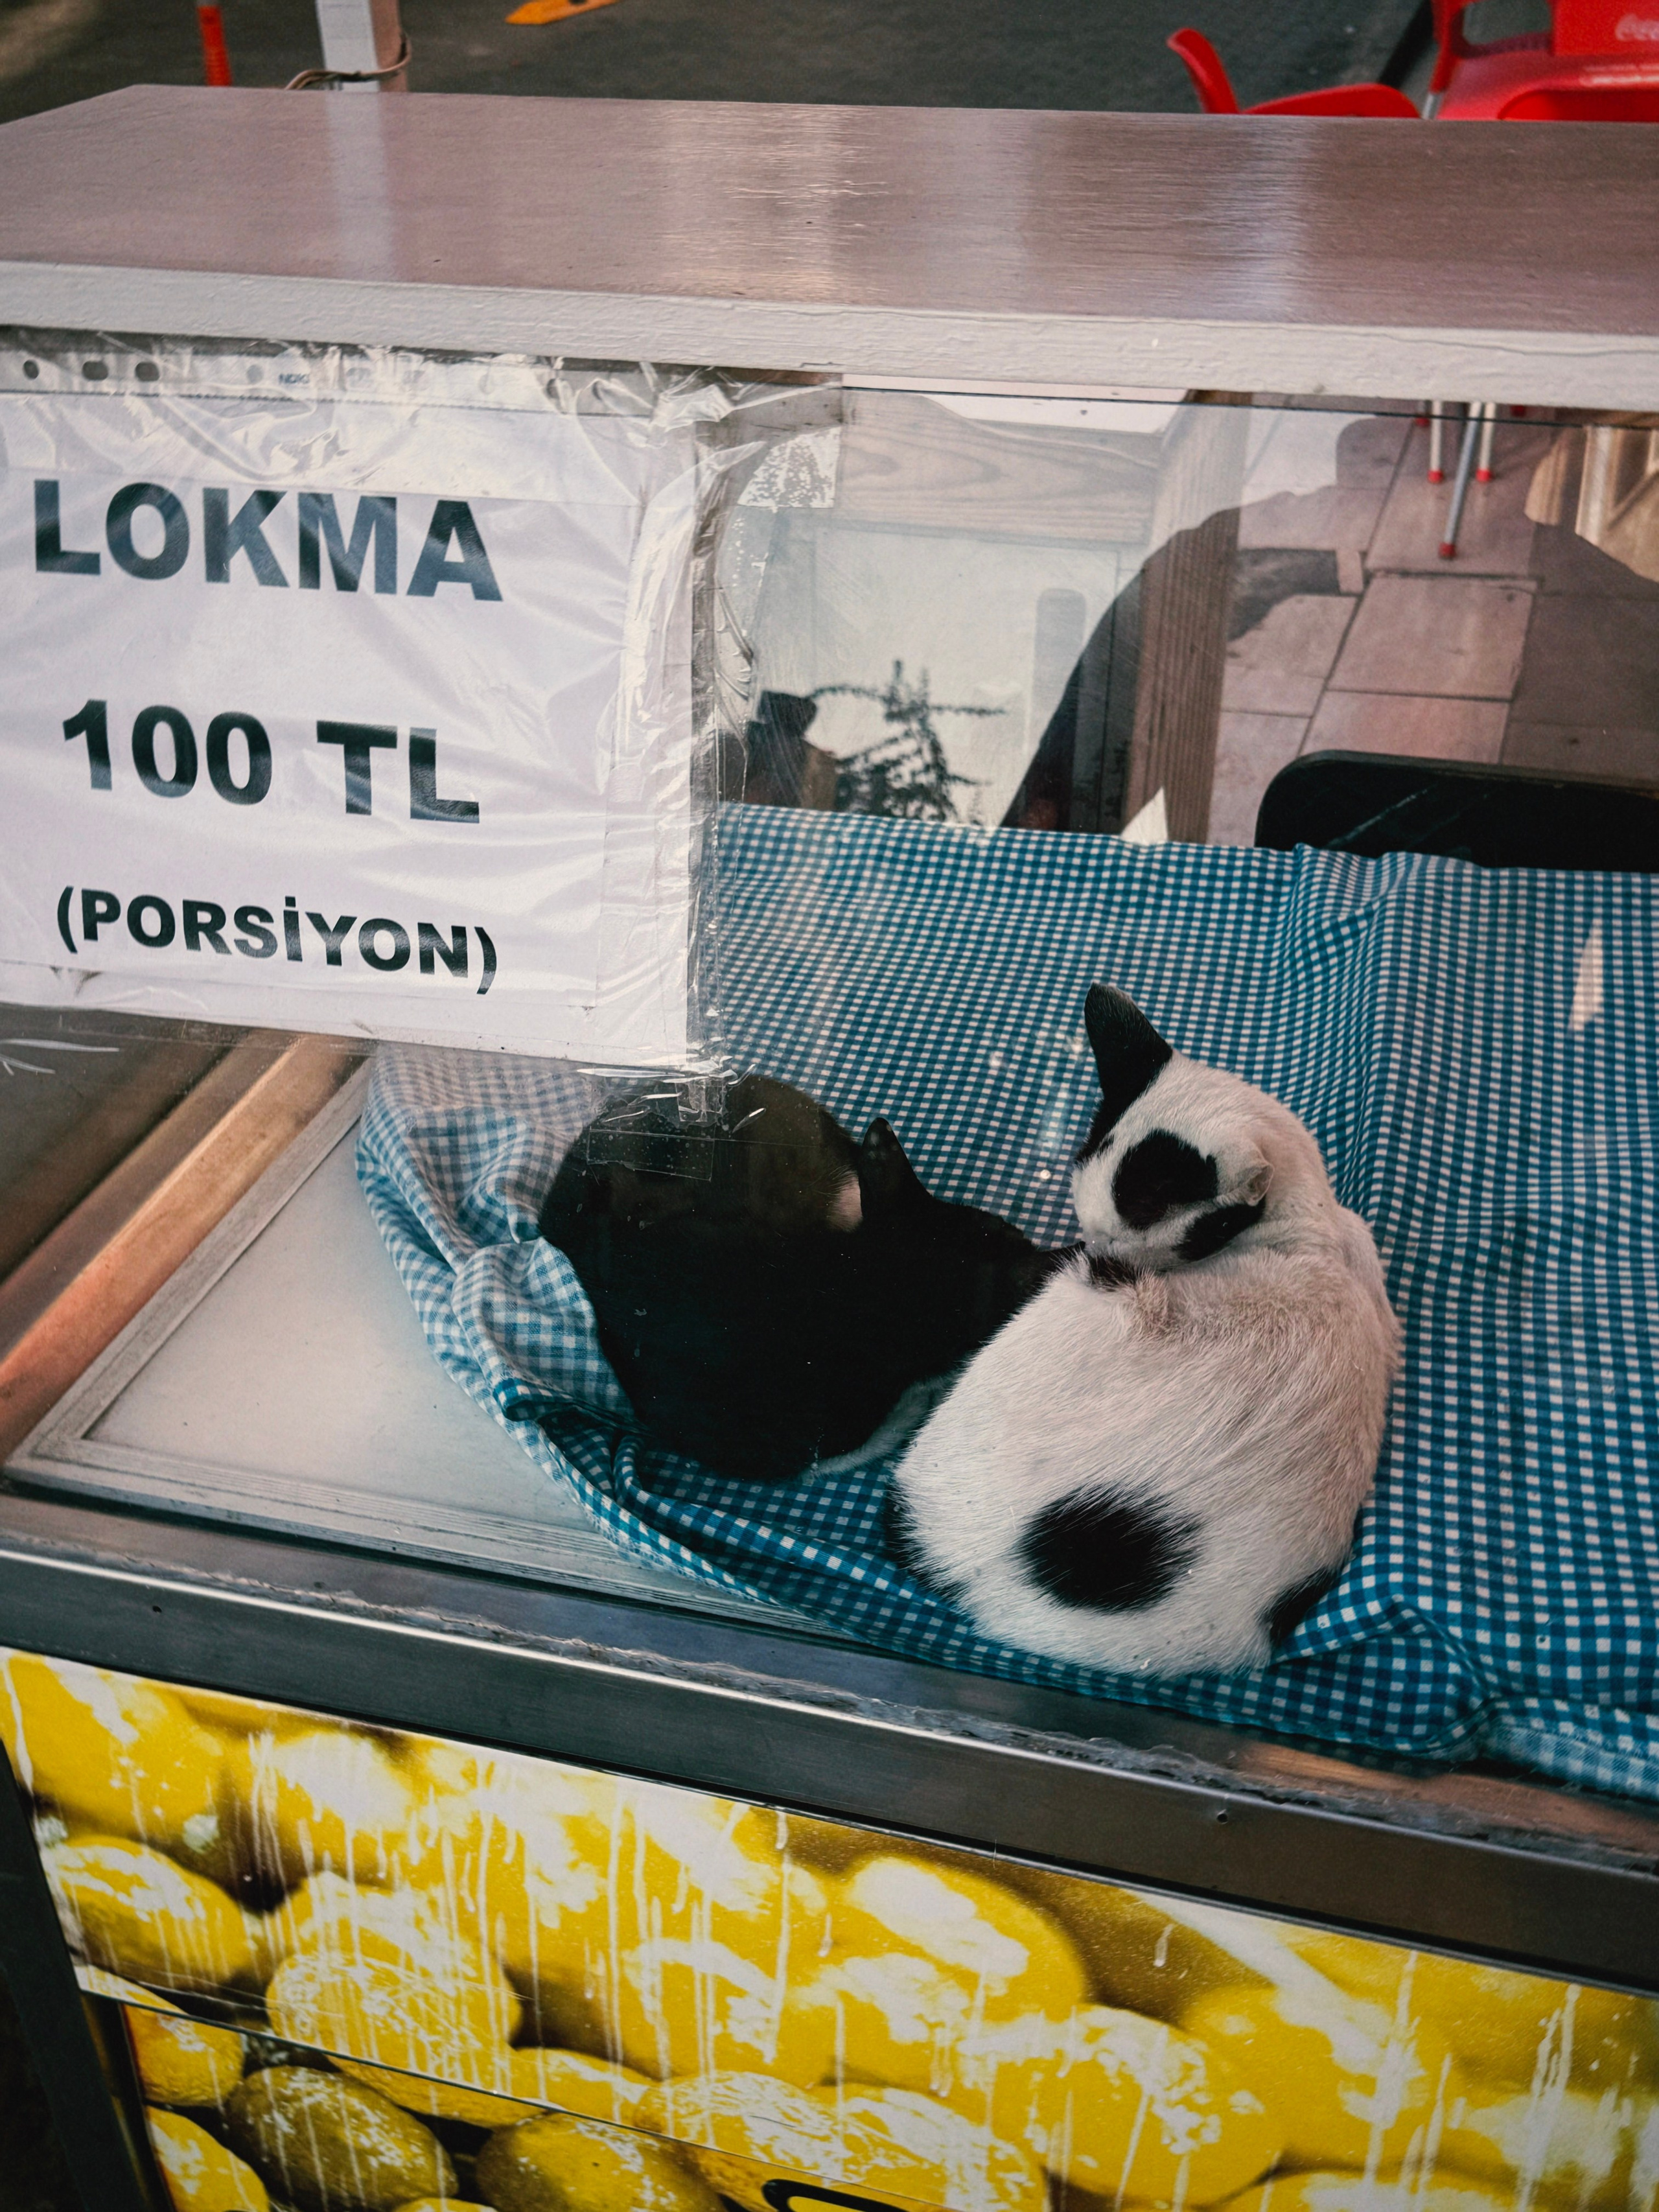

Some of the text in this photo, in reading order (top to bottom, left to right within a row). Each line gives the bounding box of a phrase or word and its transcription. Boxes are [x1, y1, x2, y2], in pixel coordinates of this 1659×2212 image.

[34, 480, 503, 601] LOKMA
[62, 699, 480, 823] 100 TL
[56, 886, 498, 995] (PORSİYON)
